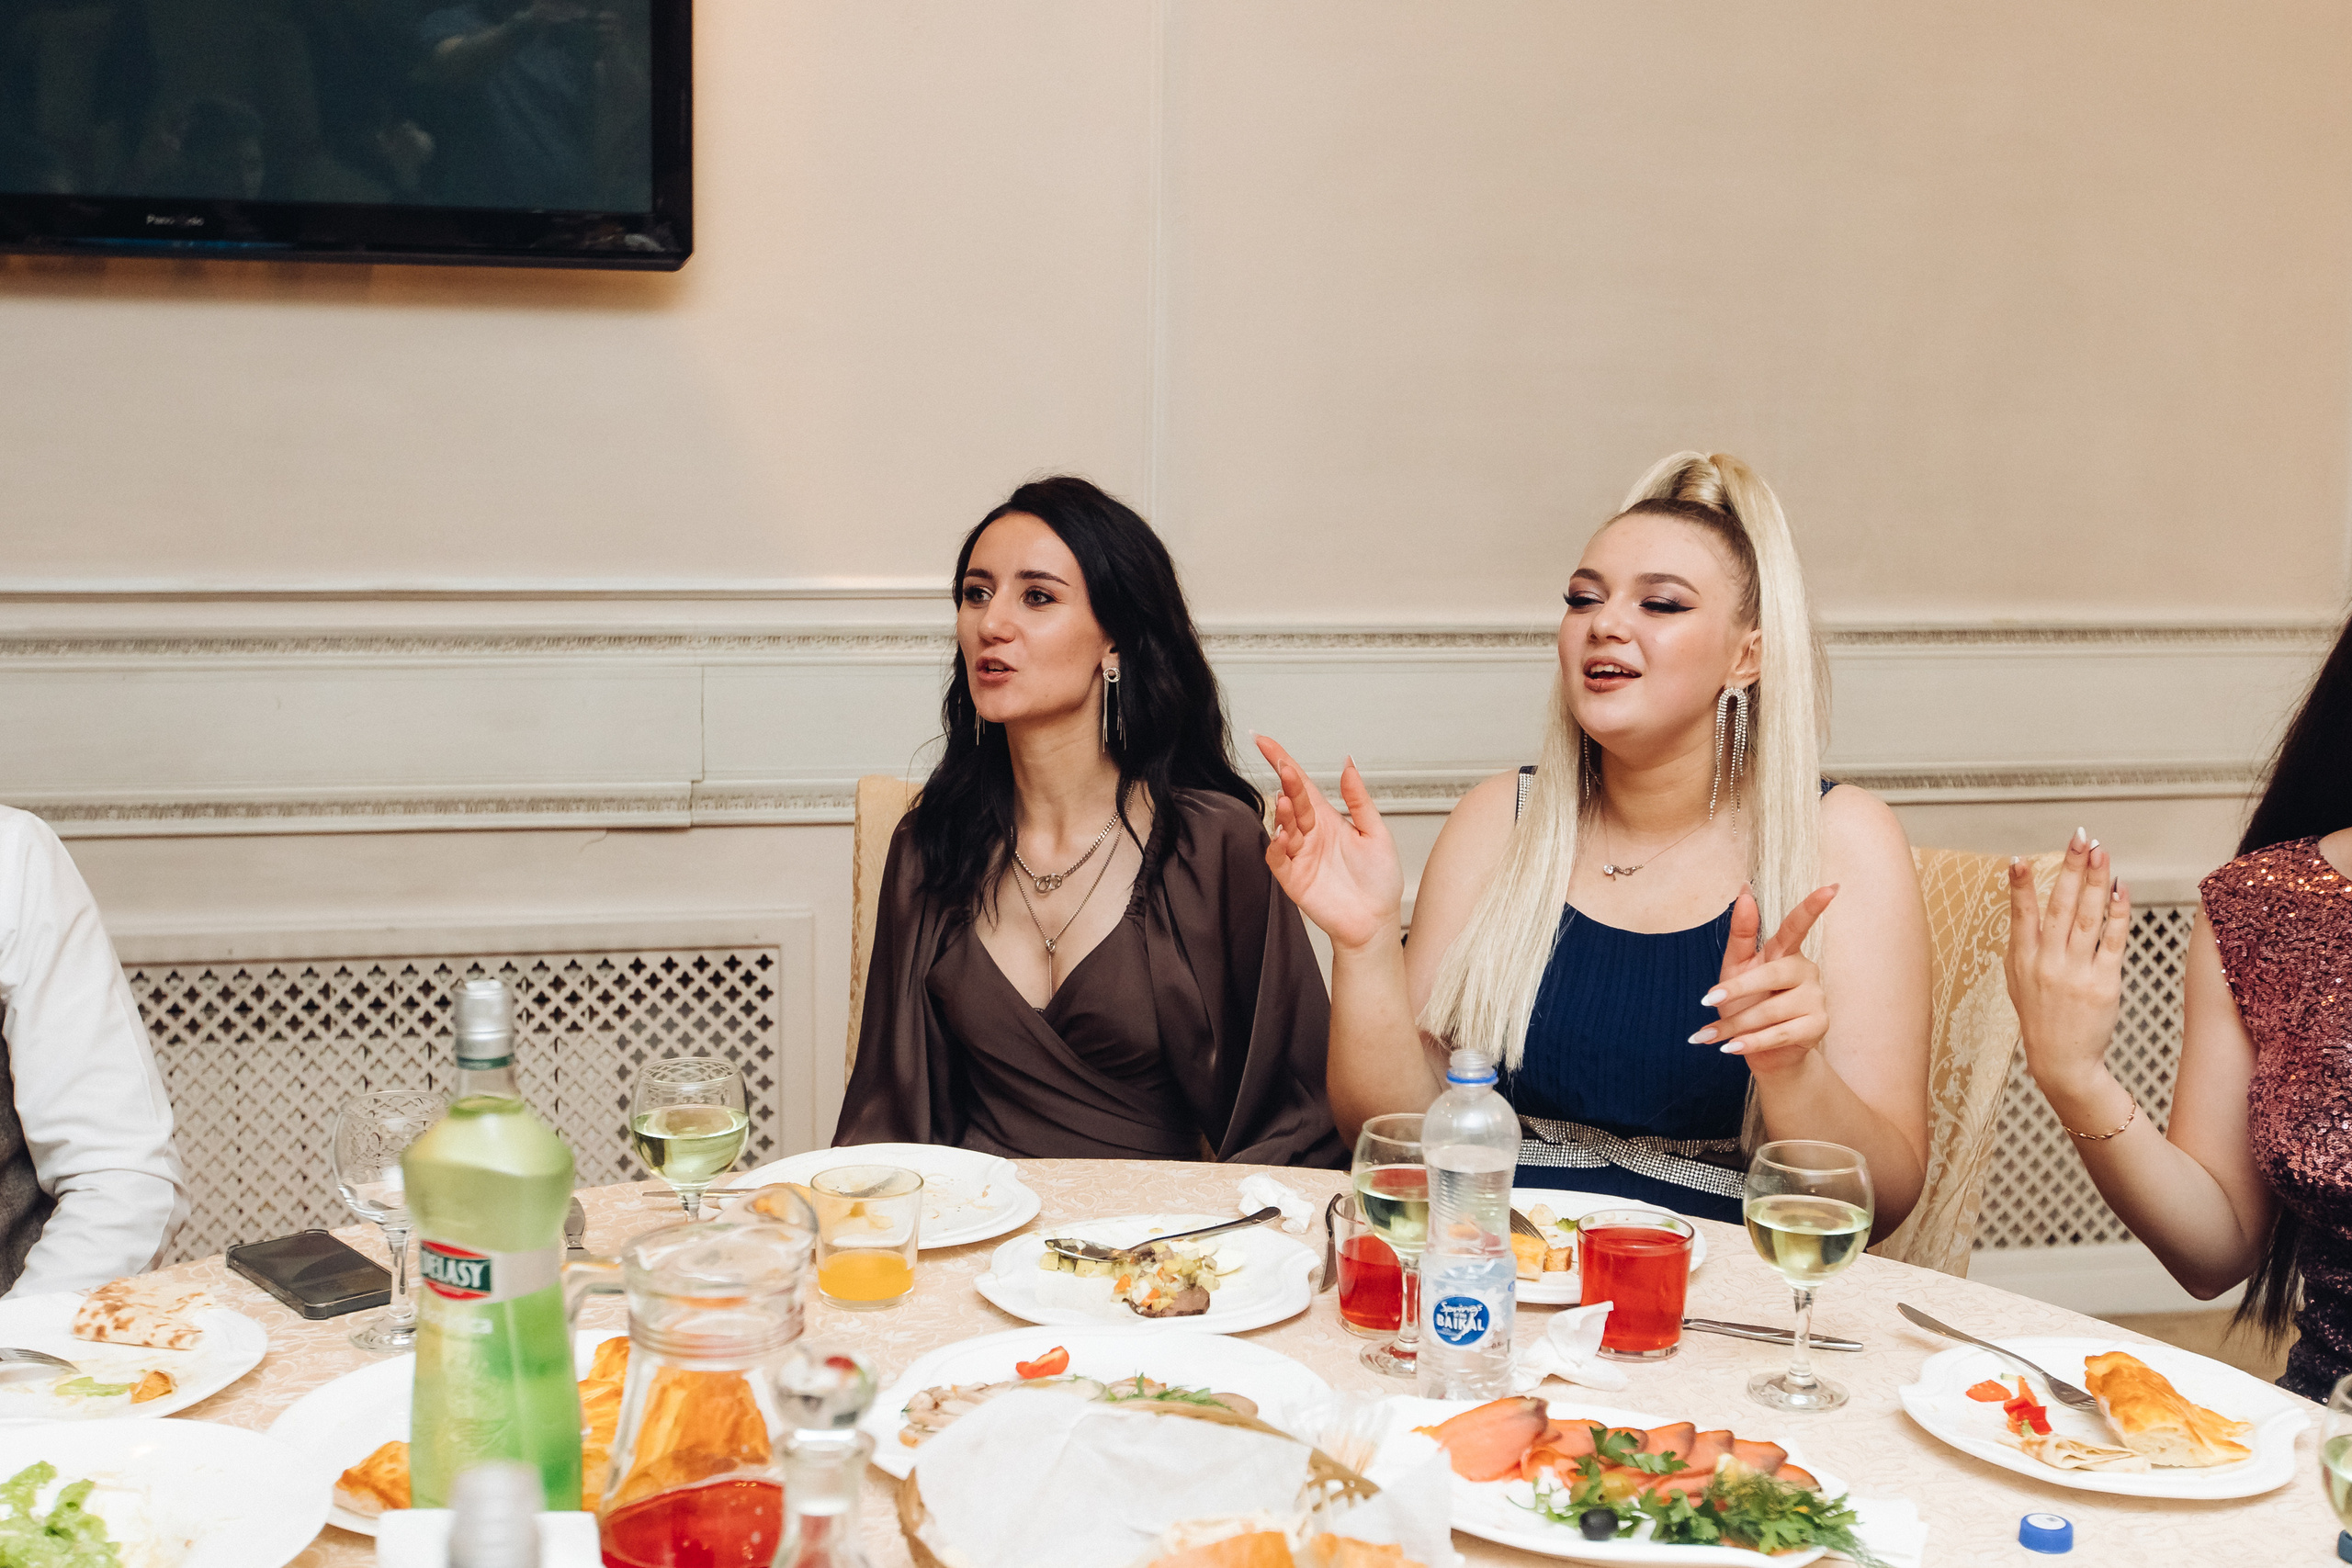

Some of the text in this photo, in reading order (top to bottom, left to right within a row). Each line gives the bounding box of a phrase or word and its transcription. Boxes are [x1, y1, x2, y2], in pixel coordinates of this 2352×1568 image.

[146, 214, 205, 227] Pananic
[1440, 1301, 1484, 1317] Springs
[1436, 1313, 1485, 1332] BAIKAL
